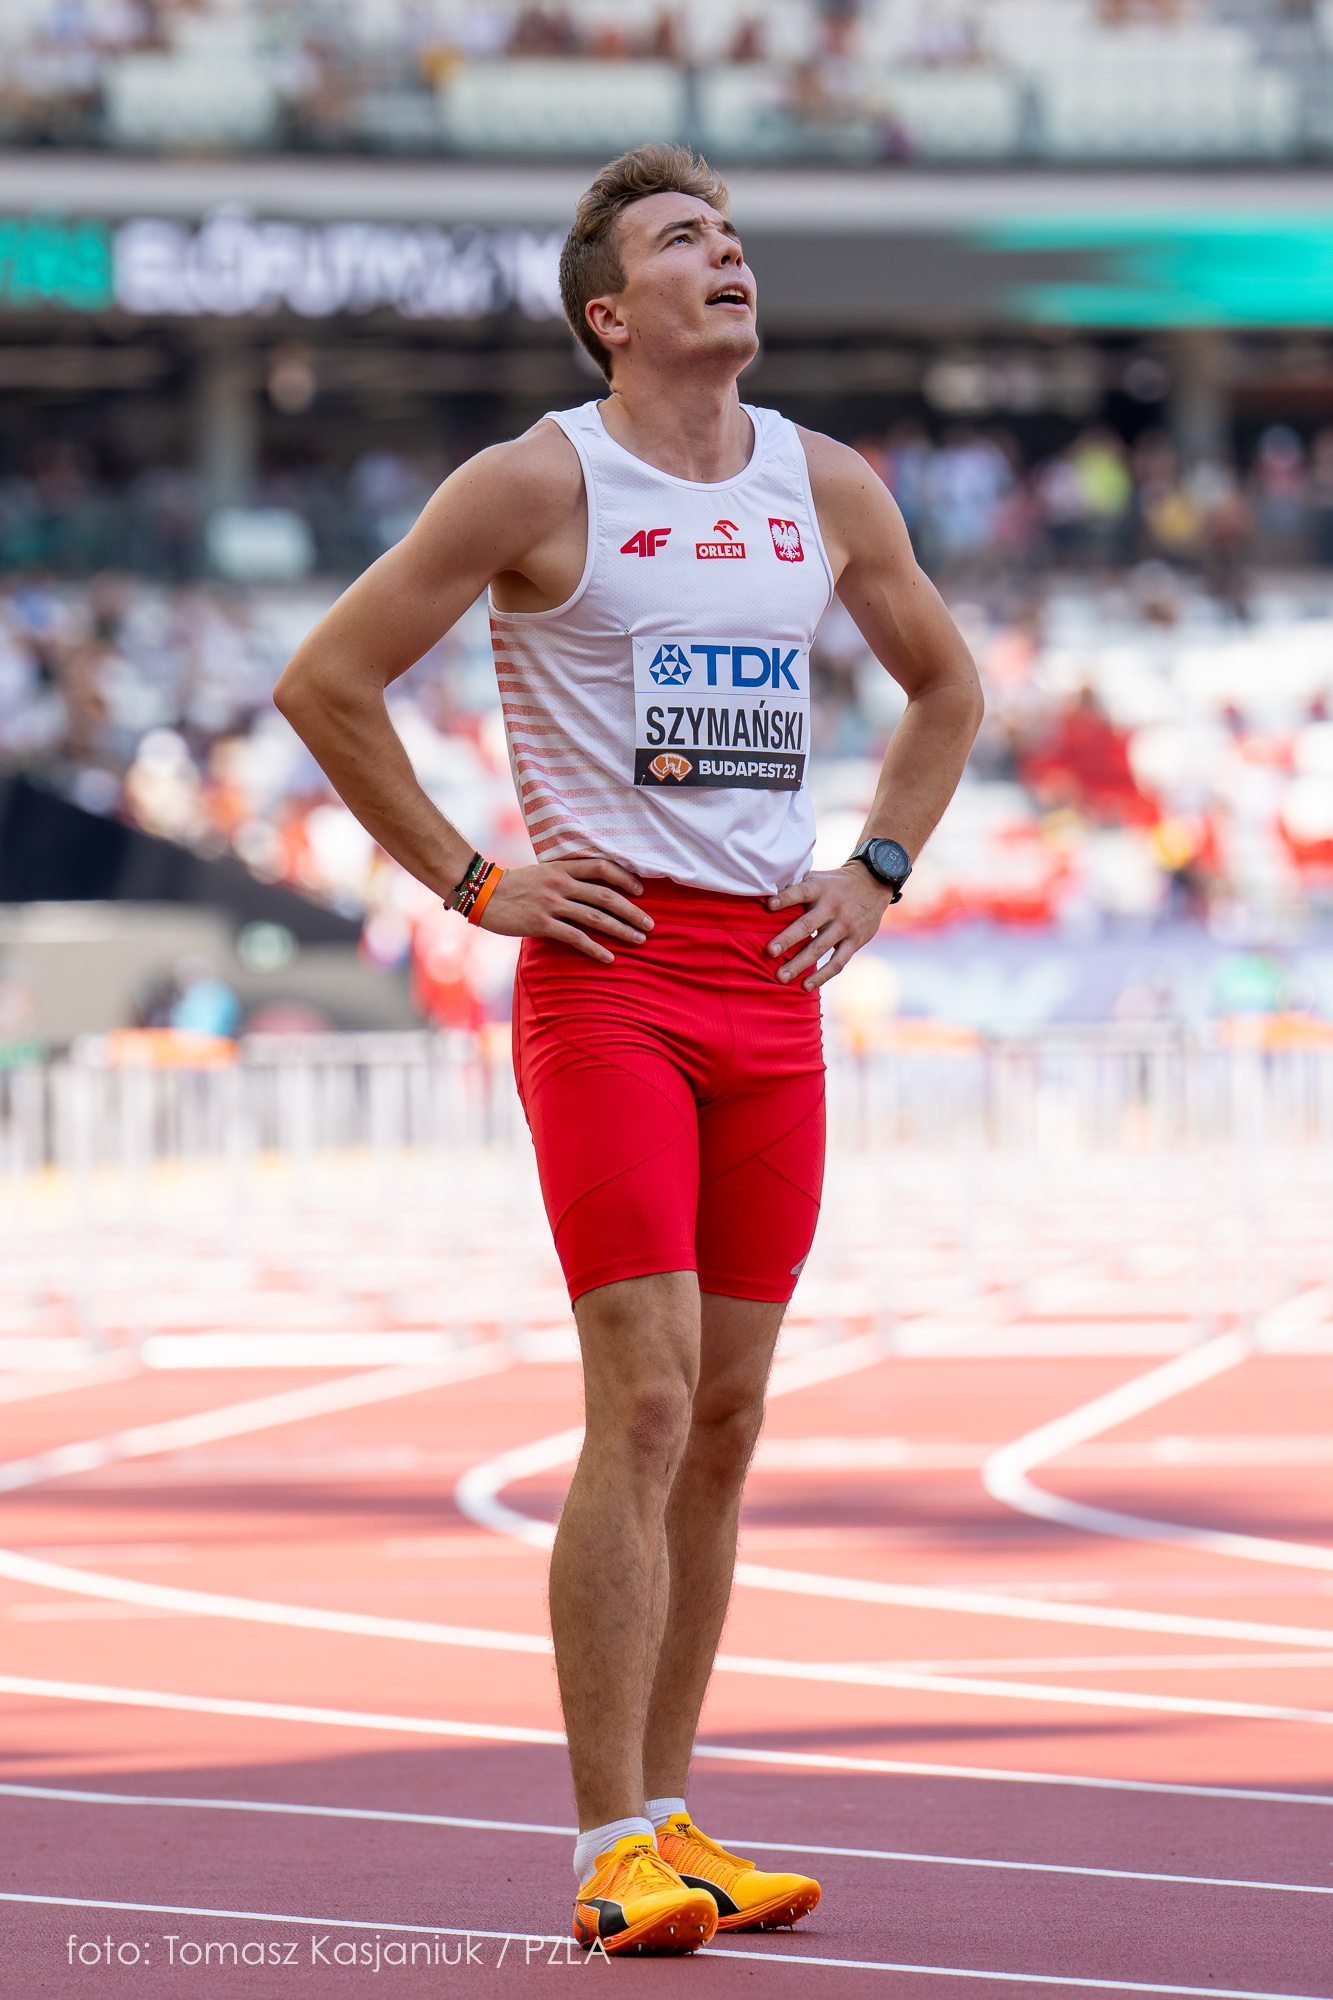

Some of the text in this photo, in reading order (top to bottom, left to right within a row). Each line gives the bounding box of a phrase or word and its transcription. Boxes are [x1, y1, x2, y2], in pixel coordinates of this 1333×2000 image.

[620, 528, 672, 557] 4F
[698, 544, 743, 557] ORLEN
[691, 644, 800, 690] TDK
[646, 700, 803, 750] SZYMAŃSKI
